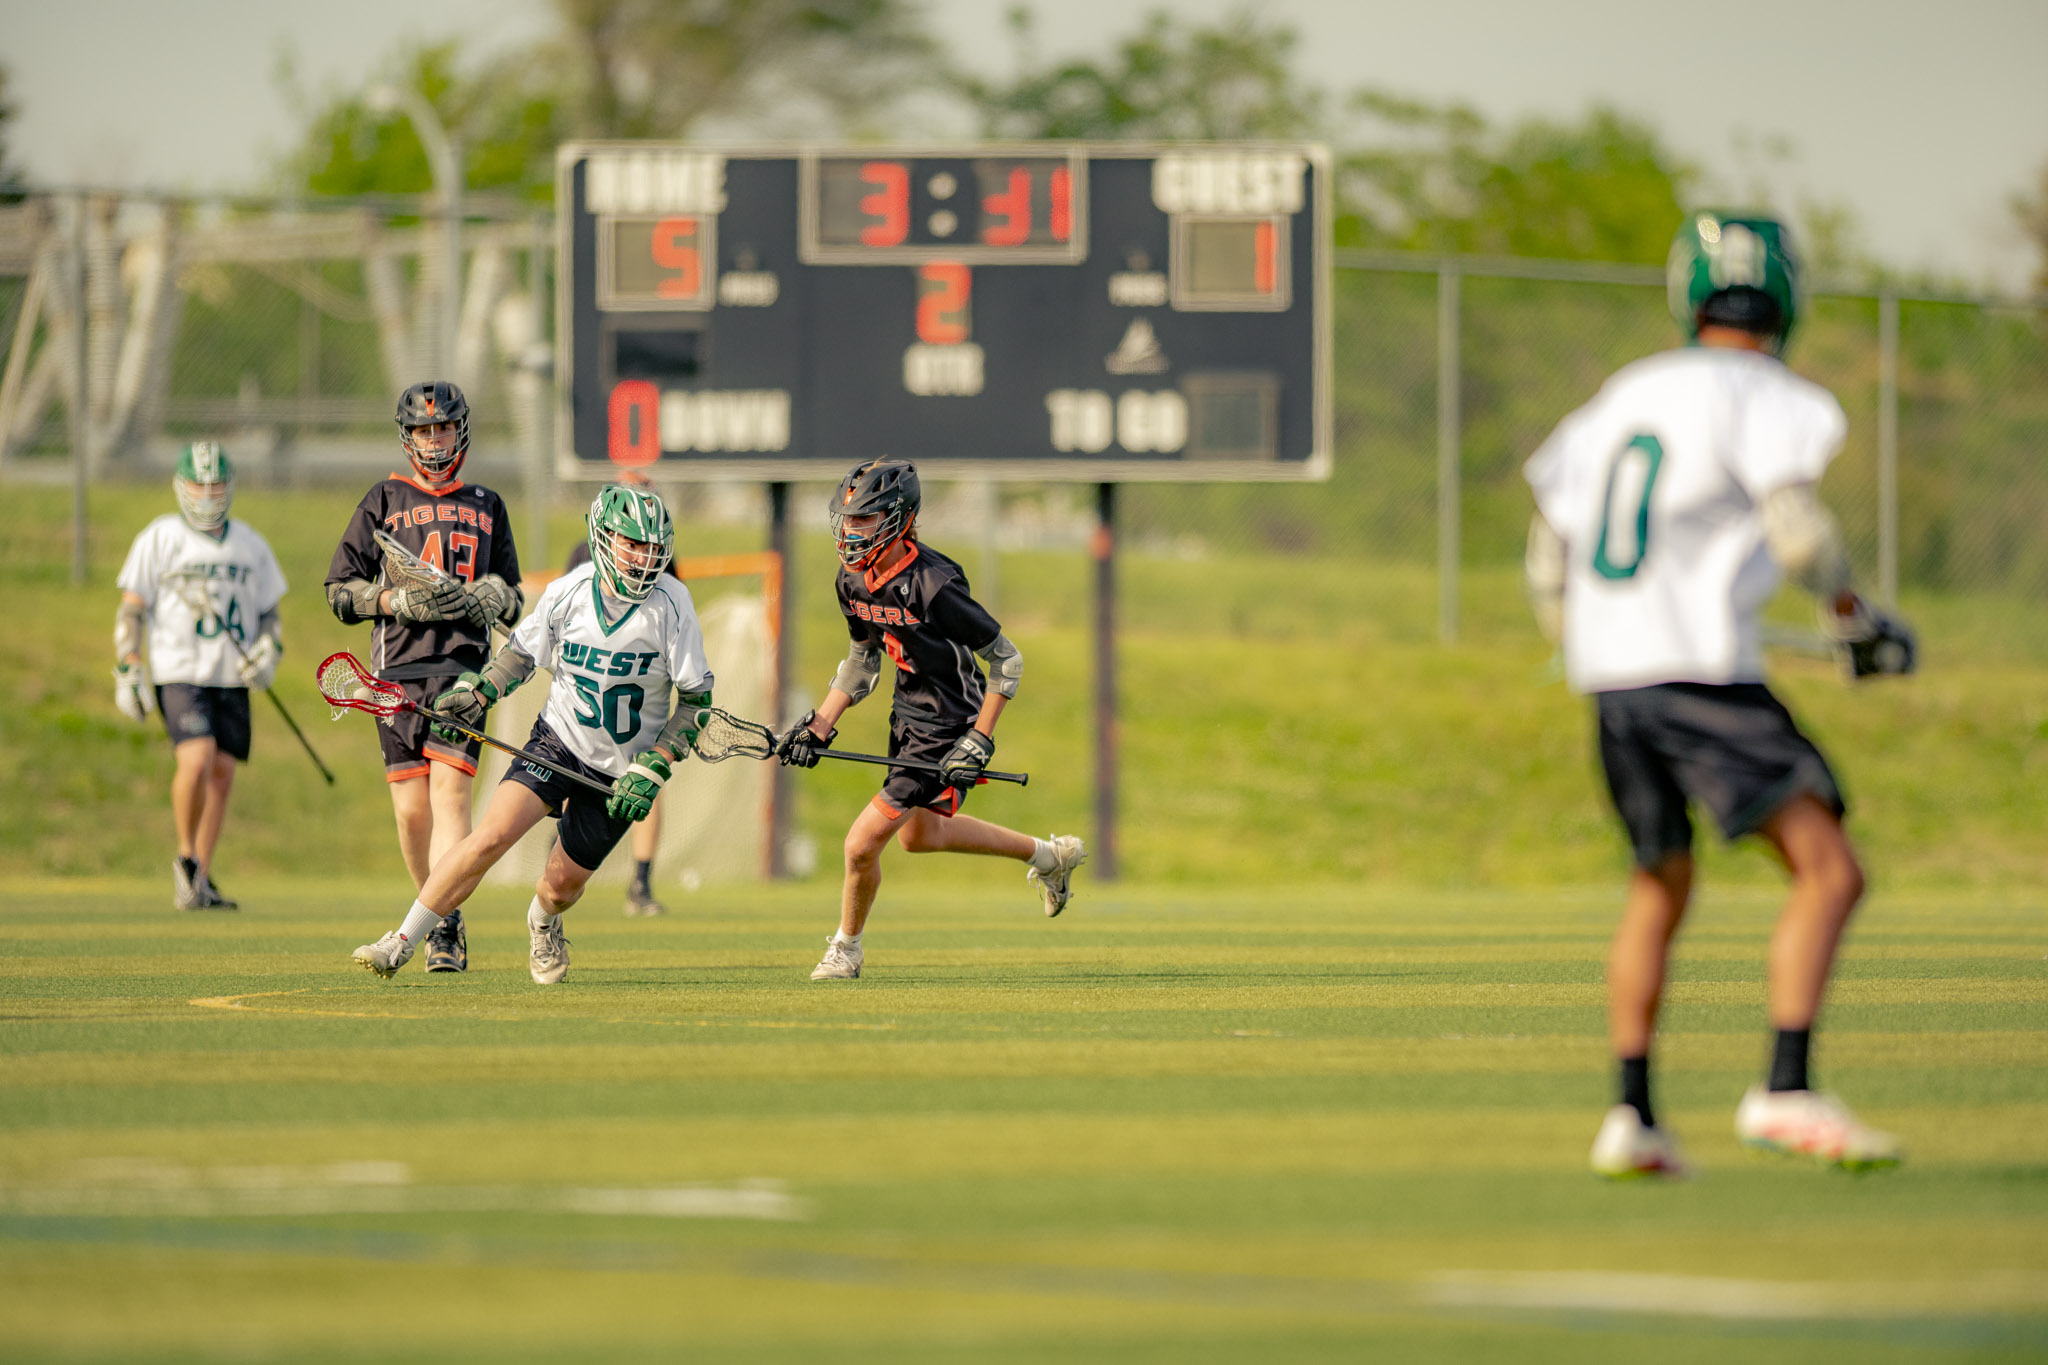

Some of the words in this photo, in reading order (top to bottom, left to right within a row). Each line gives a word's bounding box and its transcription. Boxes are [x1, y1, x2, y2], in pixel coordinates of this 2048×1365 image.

[652, 216, 701, 299] 5
[1254, 220, 1279, 295] 1
[916, 259, 972, 345] 2
[608, 379, 661, 467] 0
[384, 504, 493, 535] TIGERS
[1594, 435, 1662, 579] 0
[849, 599, 921, 626] GERS
[561, 640, 660, 677] WEST
[573, 672, 645, 745] 50
[960, 738, 990, 765] STX
